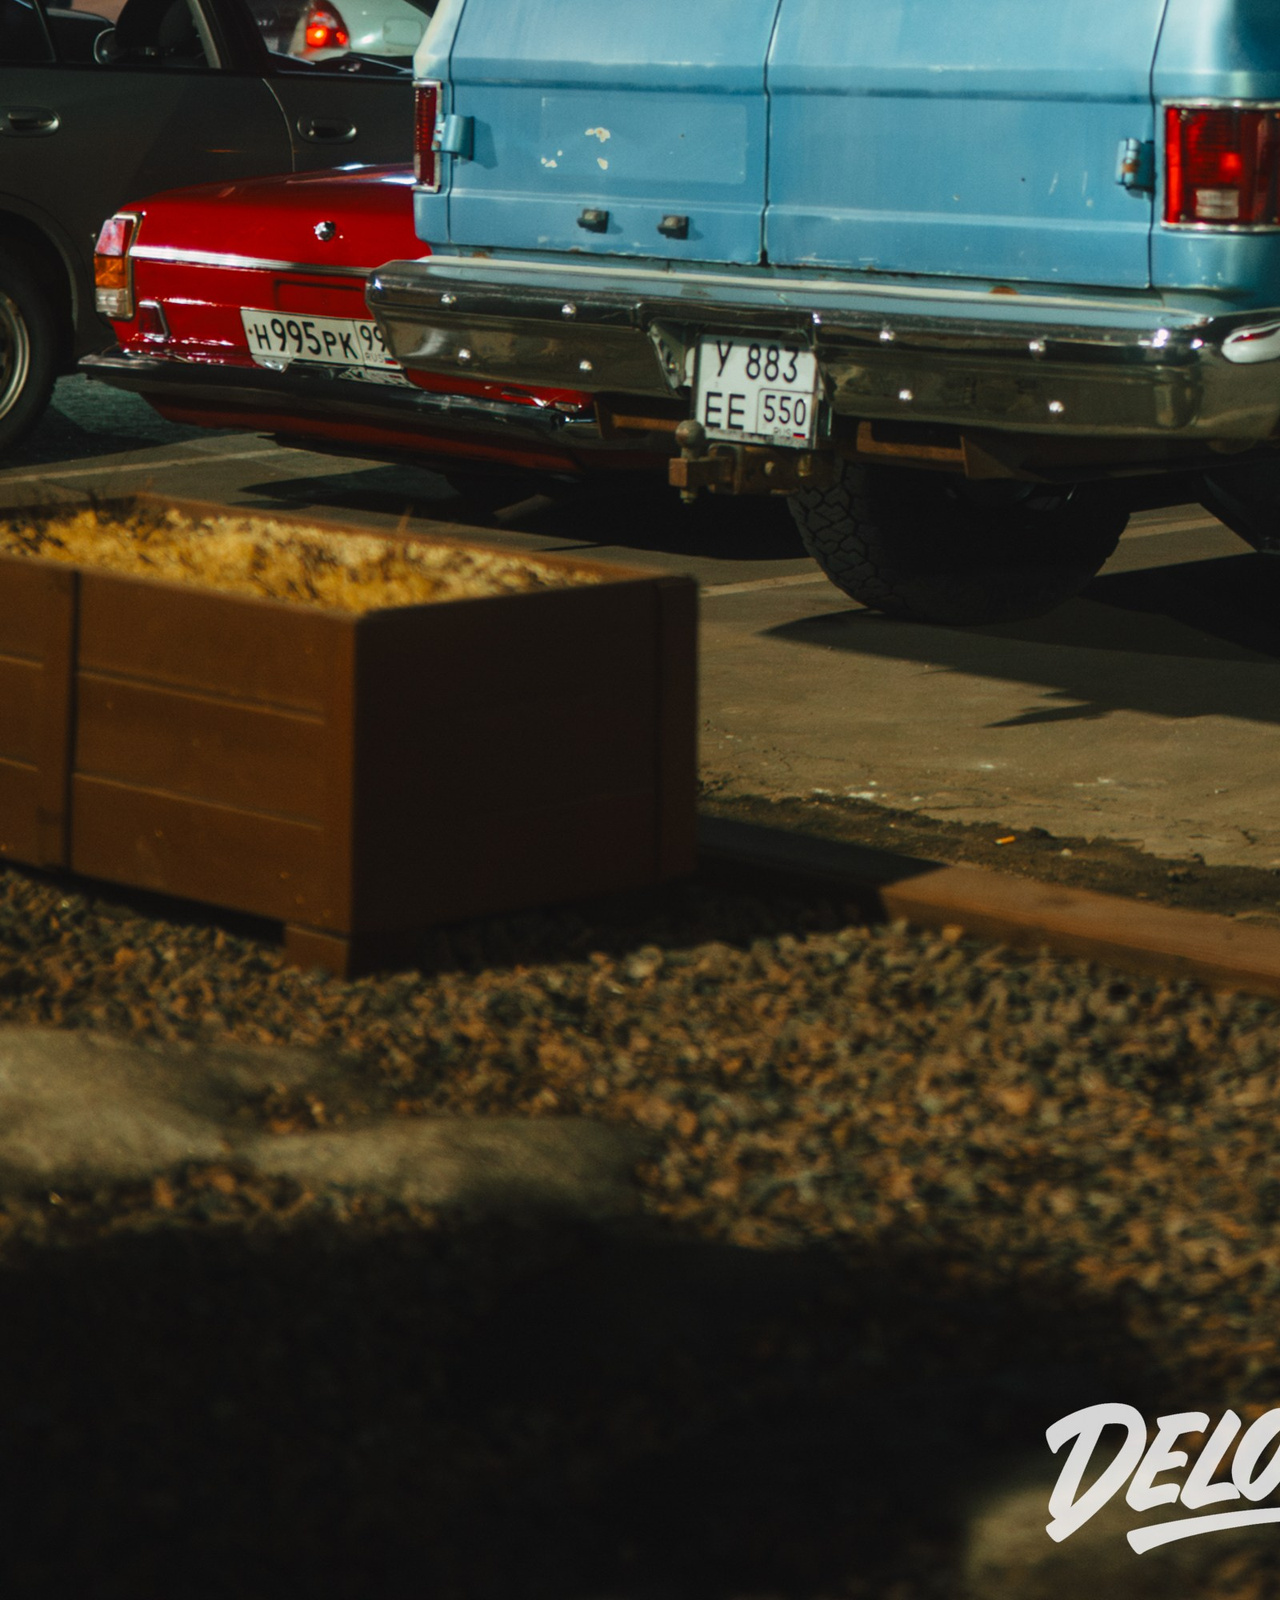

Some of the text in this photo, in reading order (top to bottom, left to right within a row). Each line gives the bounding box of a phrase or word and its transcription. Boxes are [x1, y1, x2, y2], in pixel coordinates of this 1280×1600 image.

[253, 318, 359, 360] Н995РК
[746, 343, 799, 383] 883
[704, 391, 806, 430] ЕЕ 550
